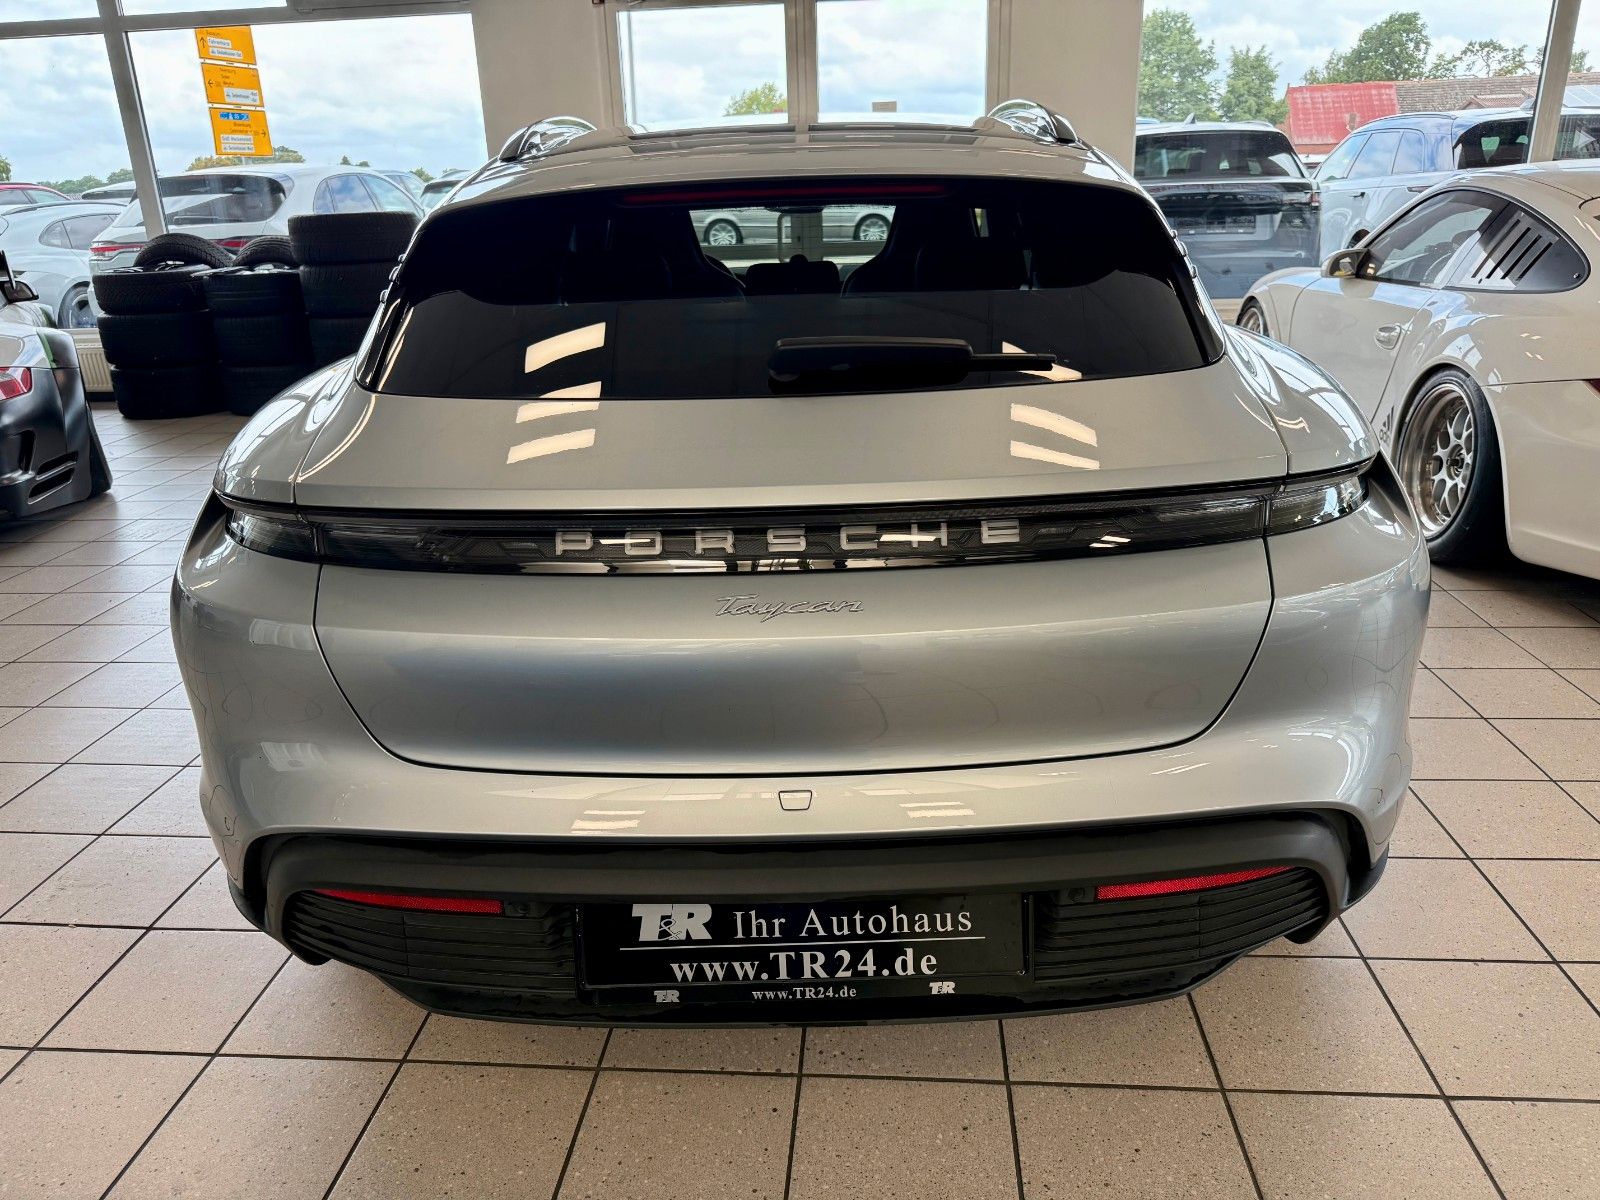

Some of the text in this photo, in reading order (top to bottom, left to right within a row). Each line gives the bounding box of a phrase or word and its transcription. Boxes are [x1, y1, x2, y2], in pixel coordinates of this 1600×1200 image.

[555, 519, 1020, 556] PORSCHE
[715, 593, 864, 623] Taycan
[732, 909, 786, 939] Ihr
[799, 904, 973, 938] Autohaus
[669, 947, 938, 983] www.TR24.de
[751, 985, 858, 1001] www.TR24.de
